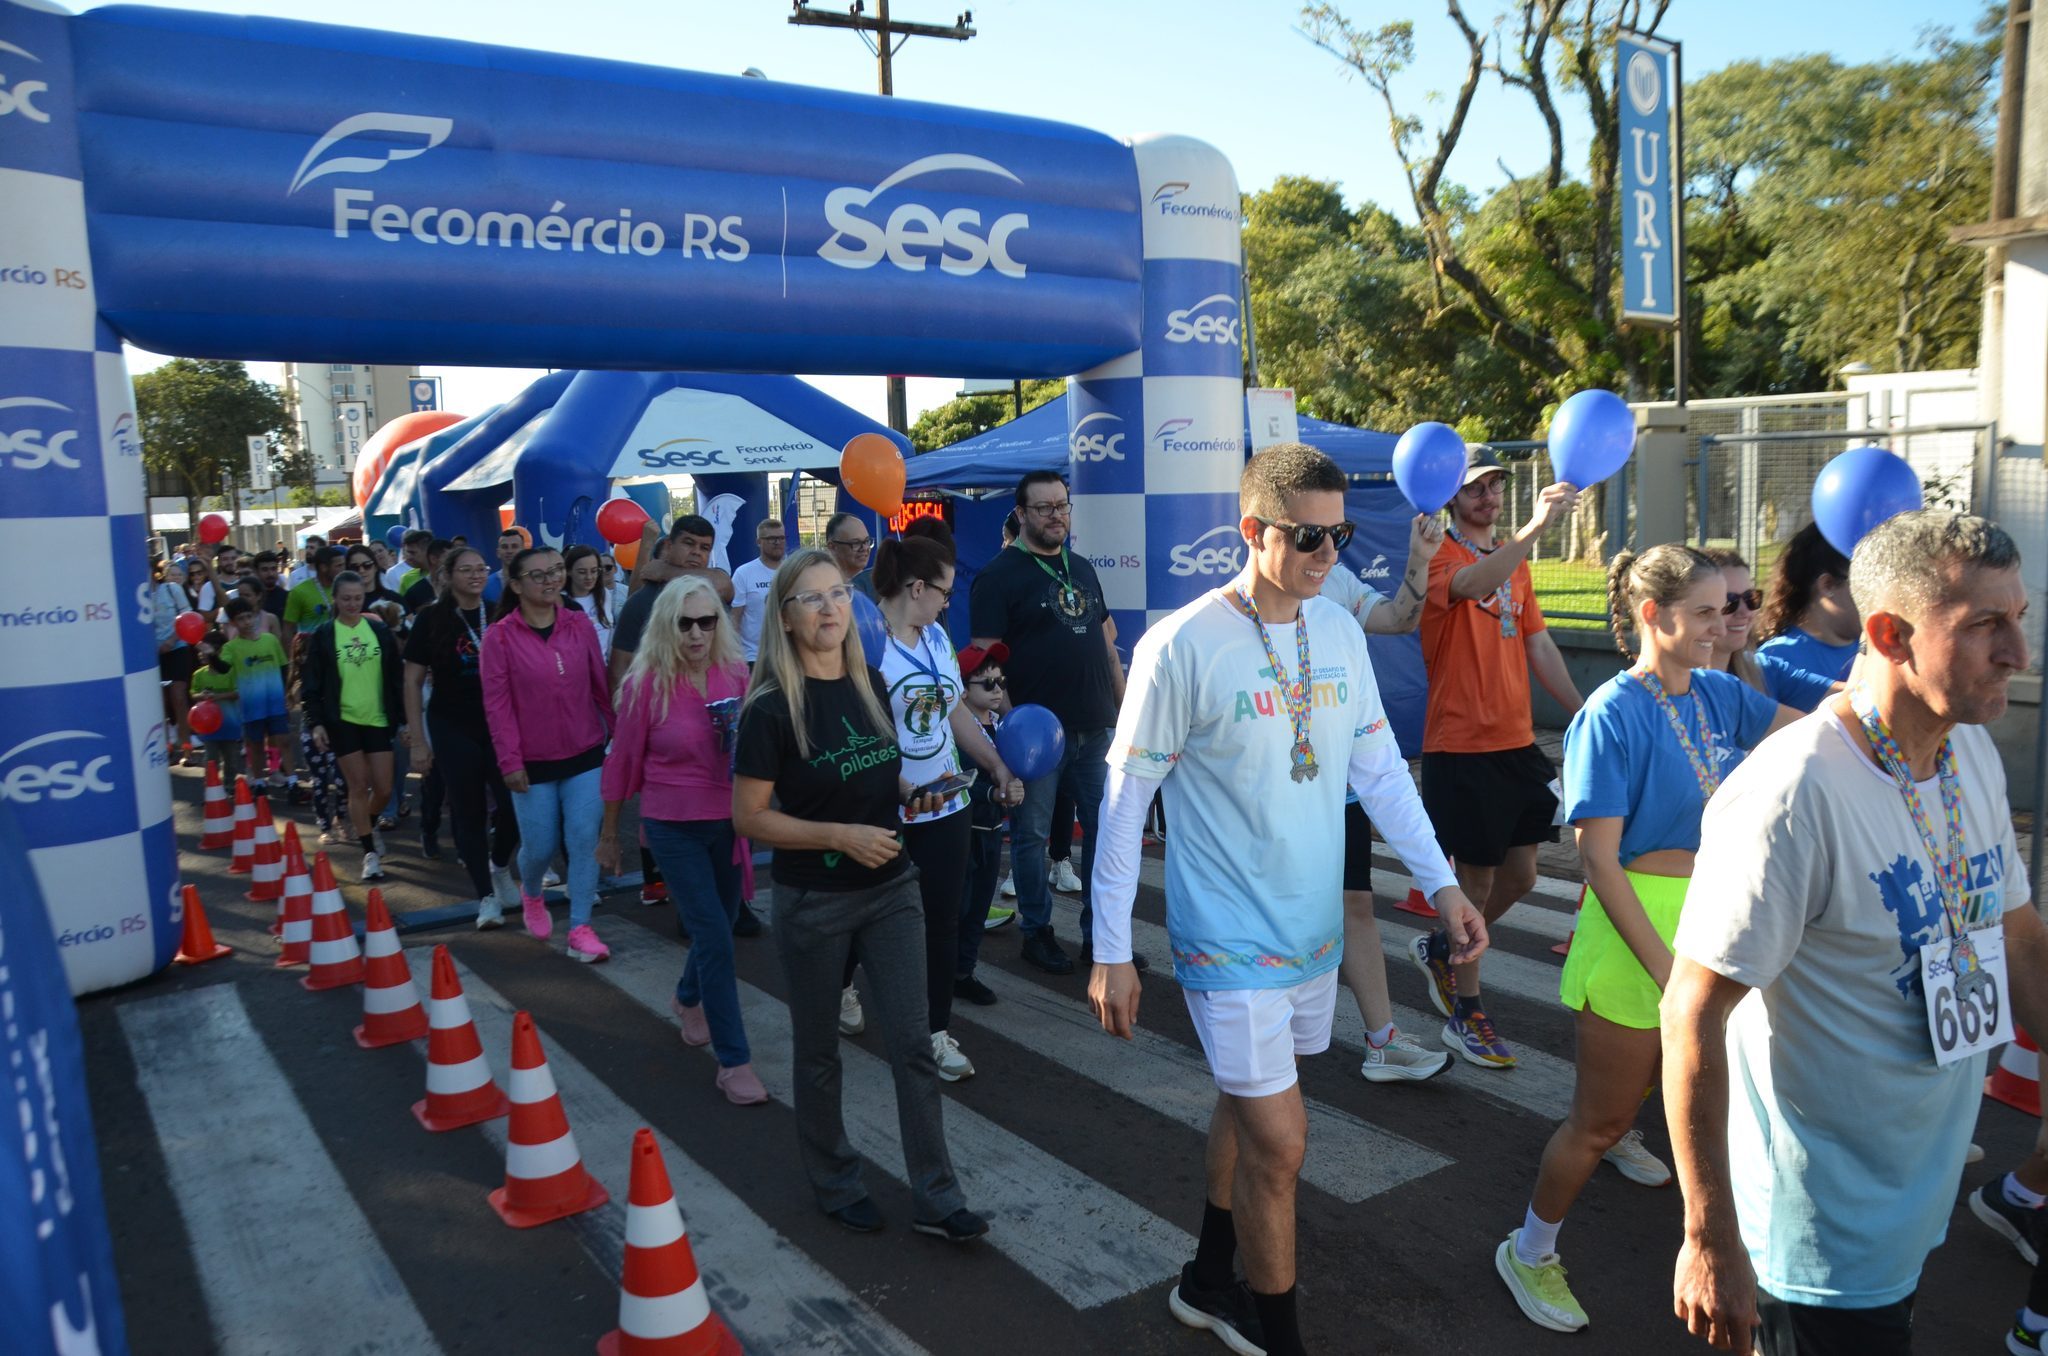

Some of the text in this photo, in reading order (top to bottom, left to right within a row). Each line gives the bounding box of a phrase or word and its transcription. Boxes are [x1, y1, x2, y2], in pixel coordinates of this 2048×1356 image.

[333, 187, 751, 262] Fecomércio RS
[816, 180, 1030, 279] Sesc
[1630, 127, 1662, 308] URI
[53, 267, 87, 290] RS
[736, 441, 815, 455] Fecomércio
[1163, 437, 1236, 452] Fecomércio
[638, 448, 731, 468] Sesc
[1119, 555, 1142, 569] RS
[84, 602, 114, 622] RS
[840, 744, 899, 782] pilates
[0, 754, 115, 803] esc
[119, 912, 148, 936] RS
[1935, 972, 1998, 1052] 669
